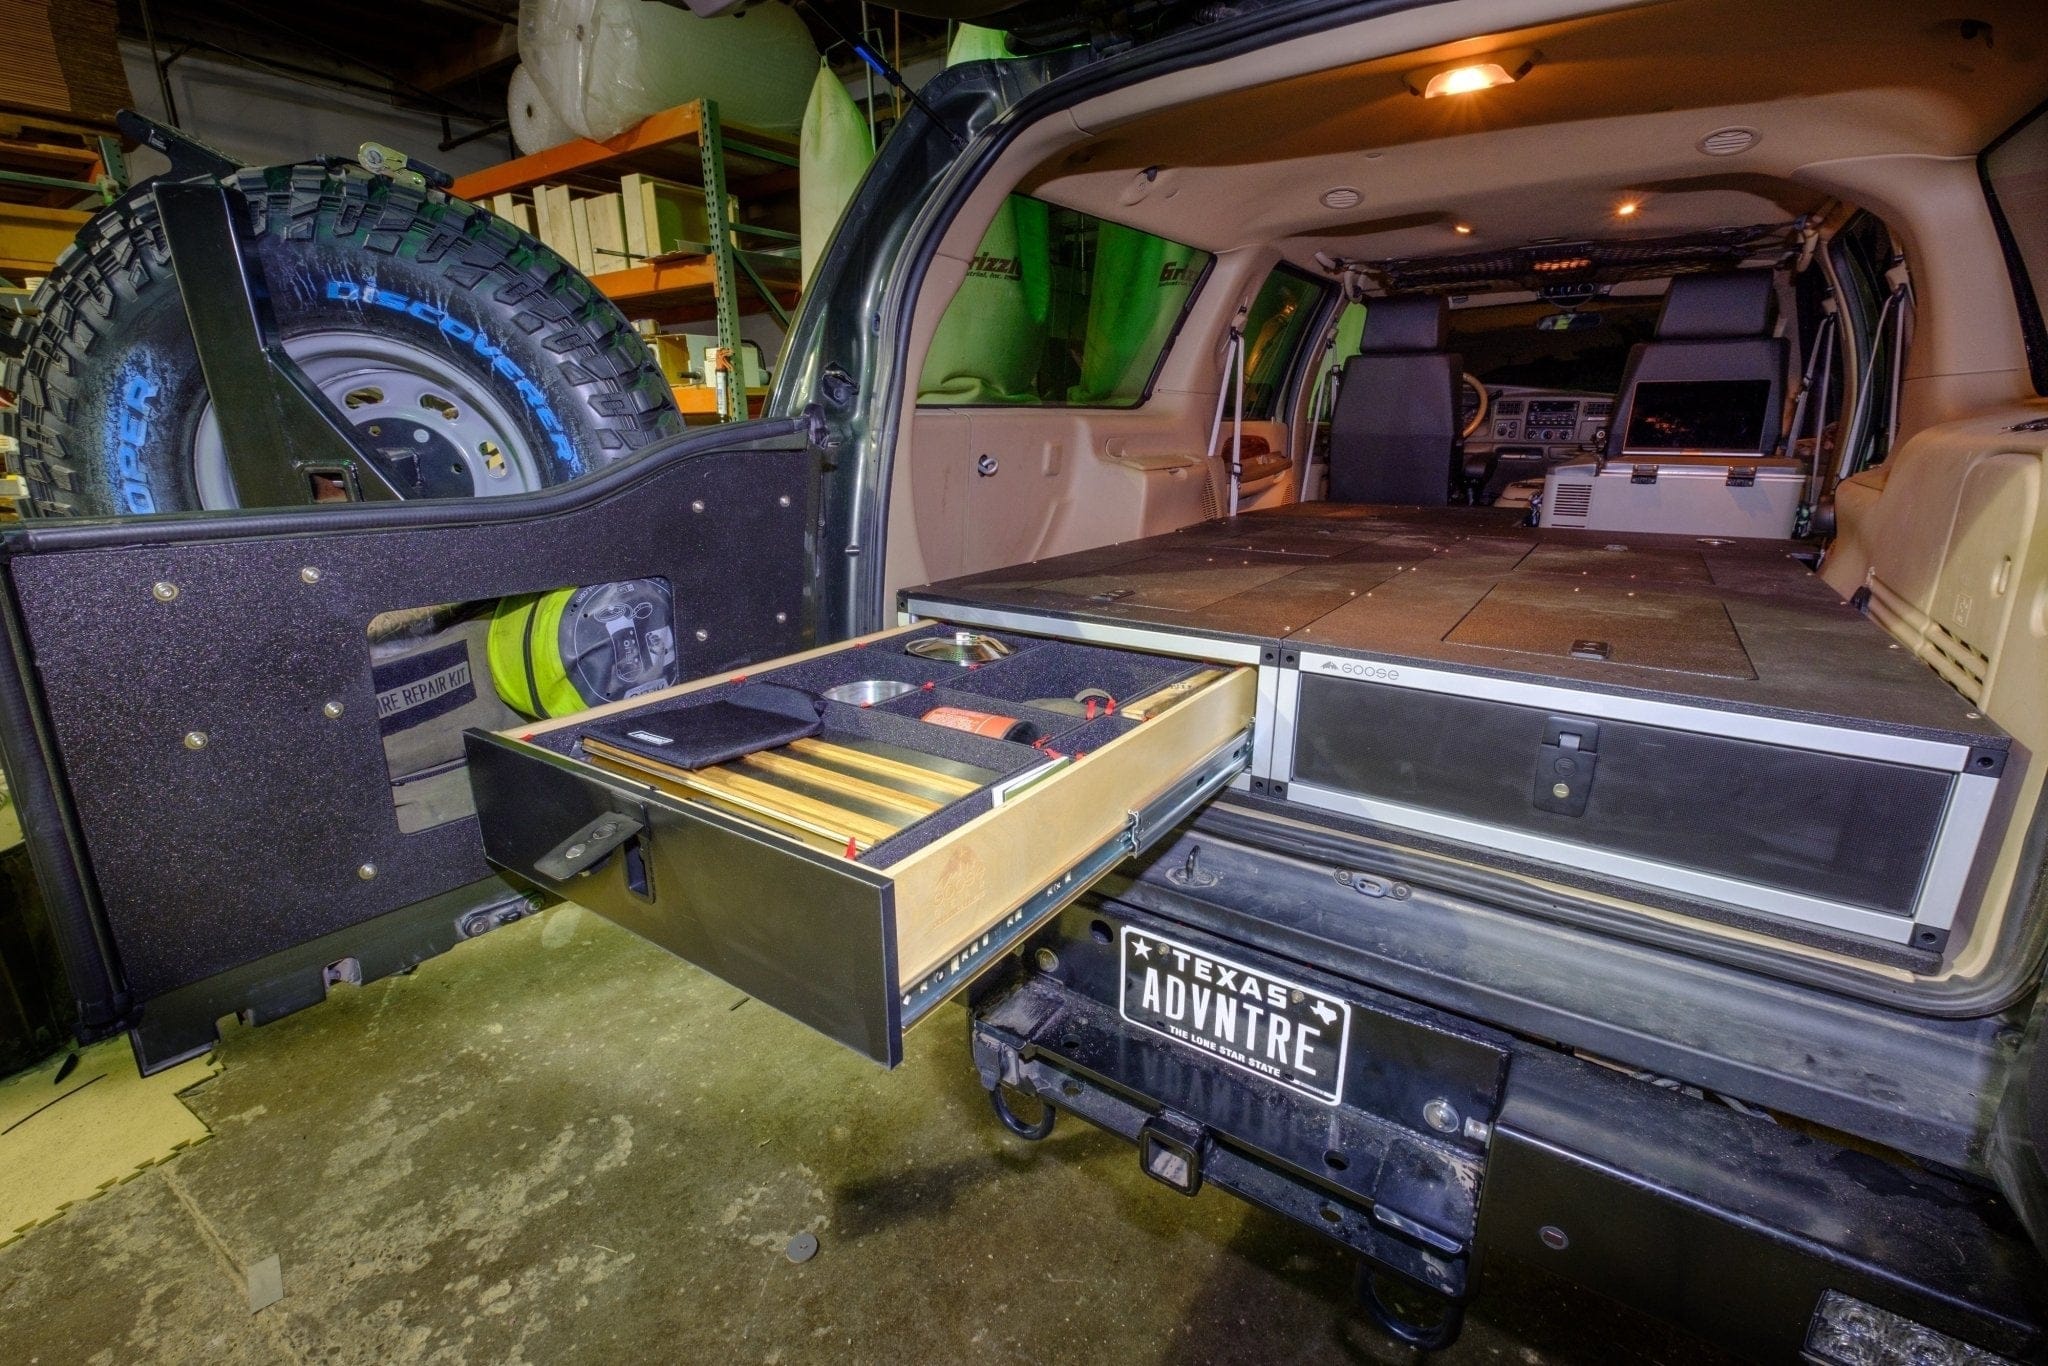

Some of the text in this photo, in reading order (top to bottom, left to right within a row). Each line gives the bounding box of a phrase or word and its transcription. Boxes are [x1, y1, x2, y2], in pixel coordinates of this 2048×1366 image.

[968, 251, 1023, 280] rizzly
[377, 667, 467, 715] IRE REPAIR KIT
[1341, 662, 1400, 681] GOOSE
[1172, 950, 1288, 1010] TEXAS
[1142, 967, 1321, 1076] ADVNTRE
[1169, 1025, 1282, 1079] THE LONE STAR STATE
